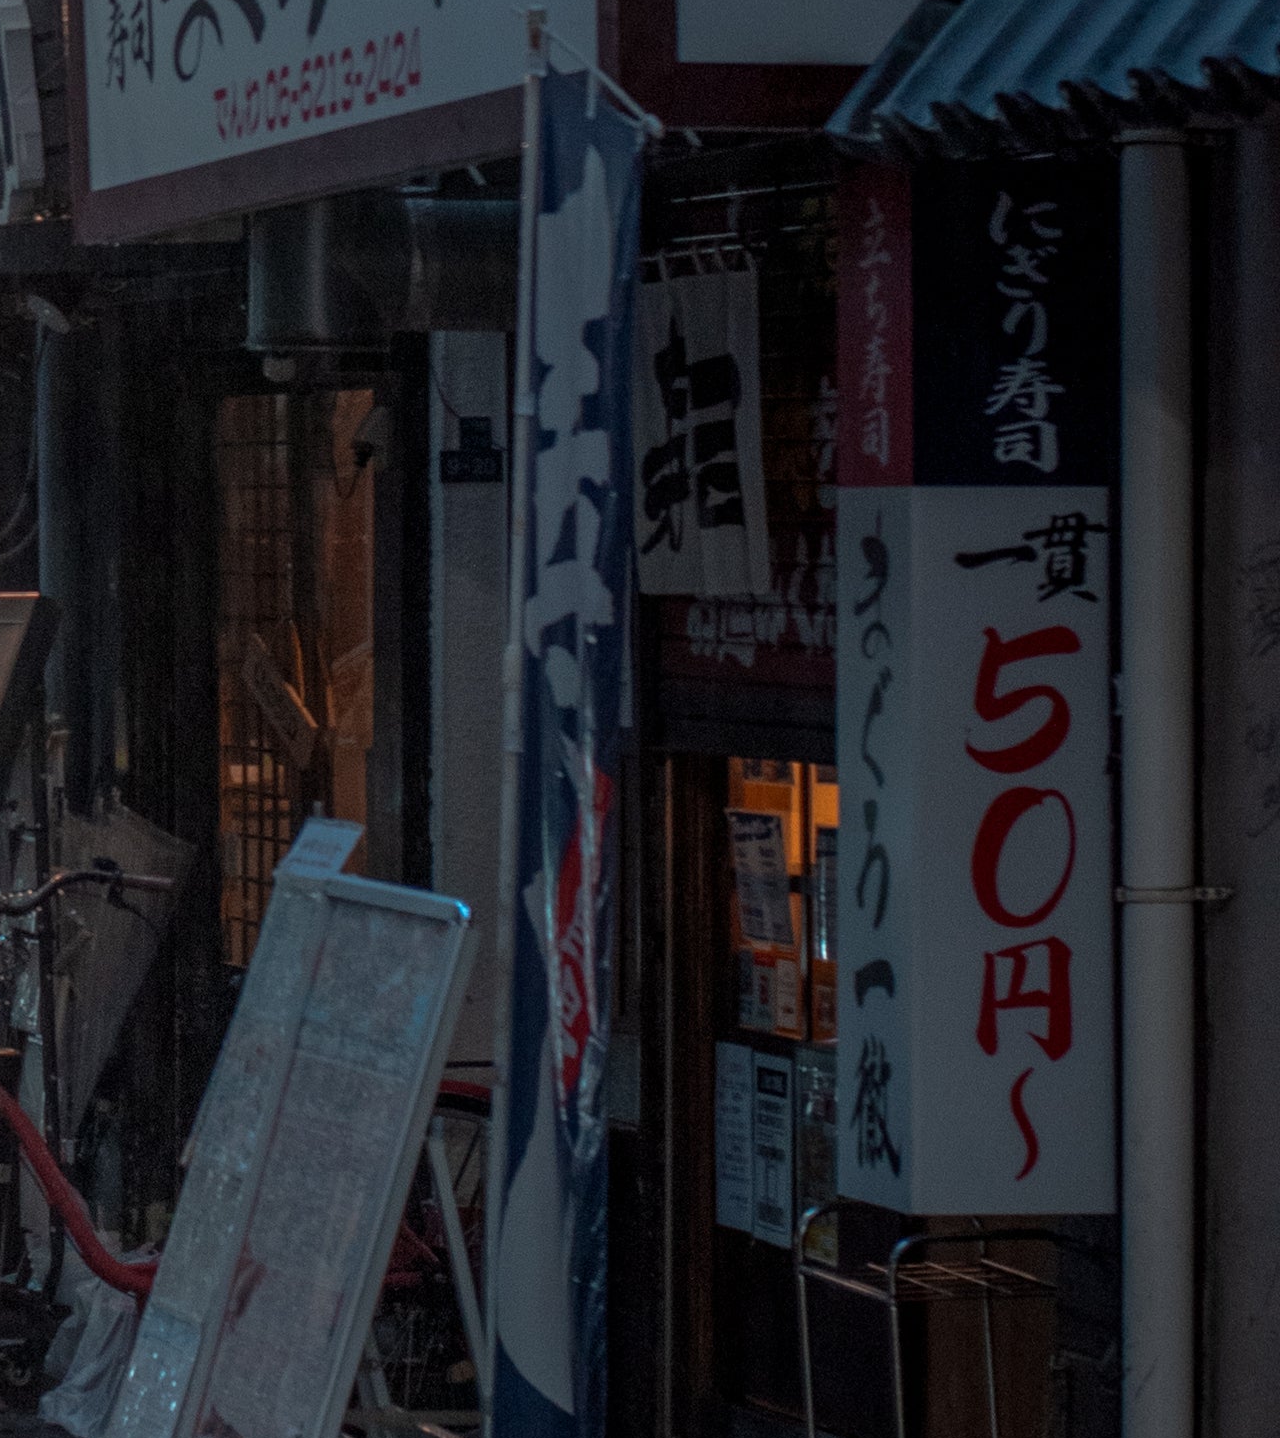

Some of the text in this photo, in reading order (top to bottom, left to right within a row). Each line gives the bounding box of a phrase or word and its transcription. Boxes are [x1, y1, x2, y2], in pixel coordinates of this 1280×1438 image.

[857, 195, 893, 468] 立ち寿司
[983, 189, 1068, 475] にぎり寿司
[953, 510, 1109, 603] 一貫
